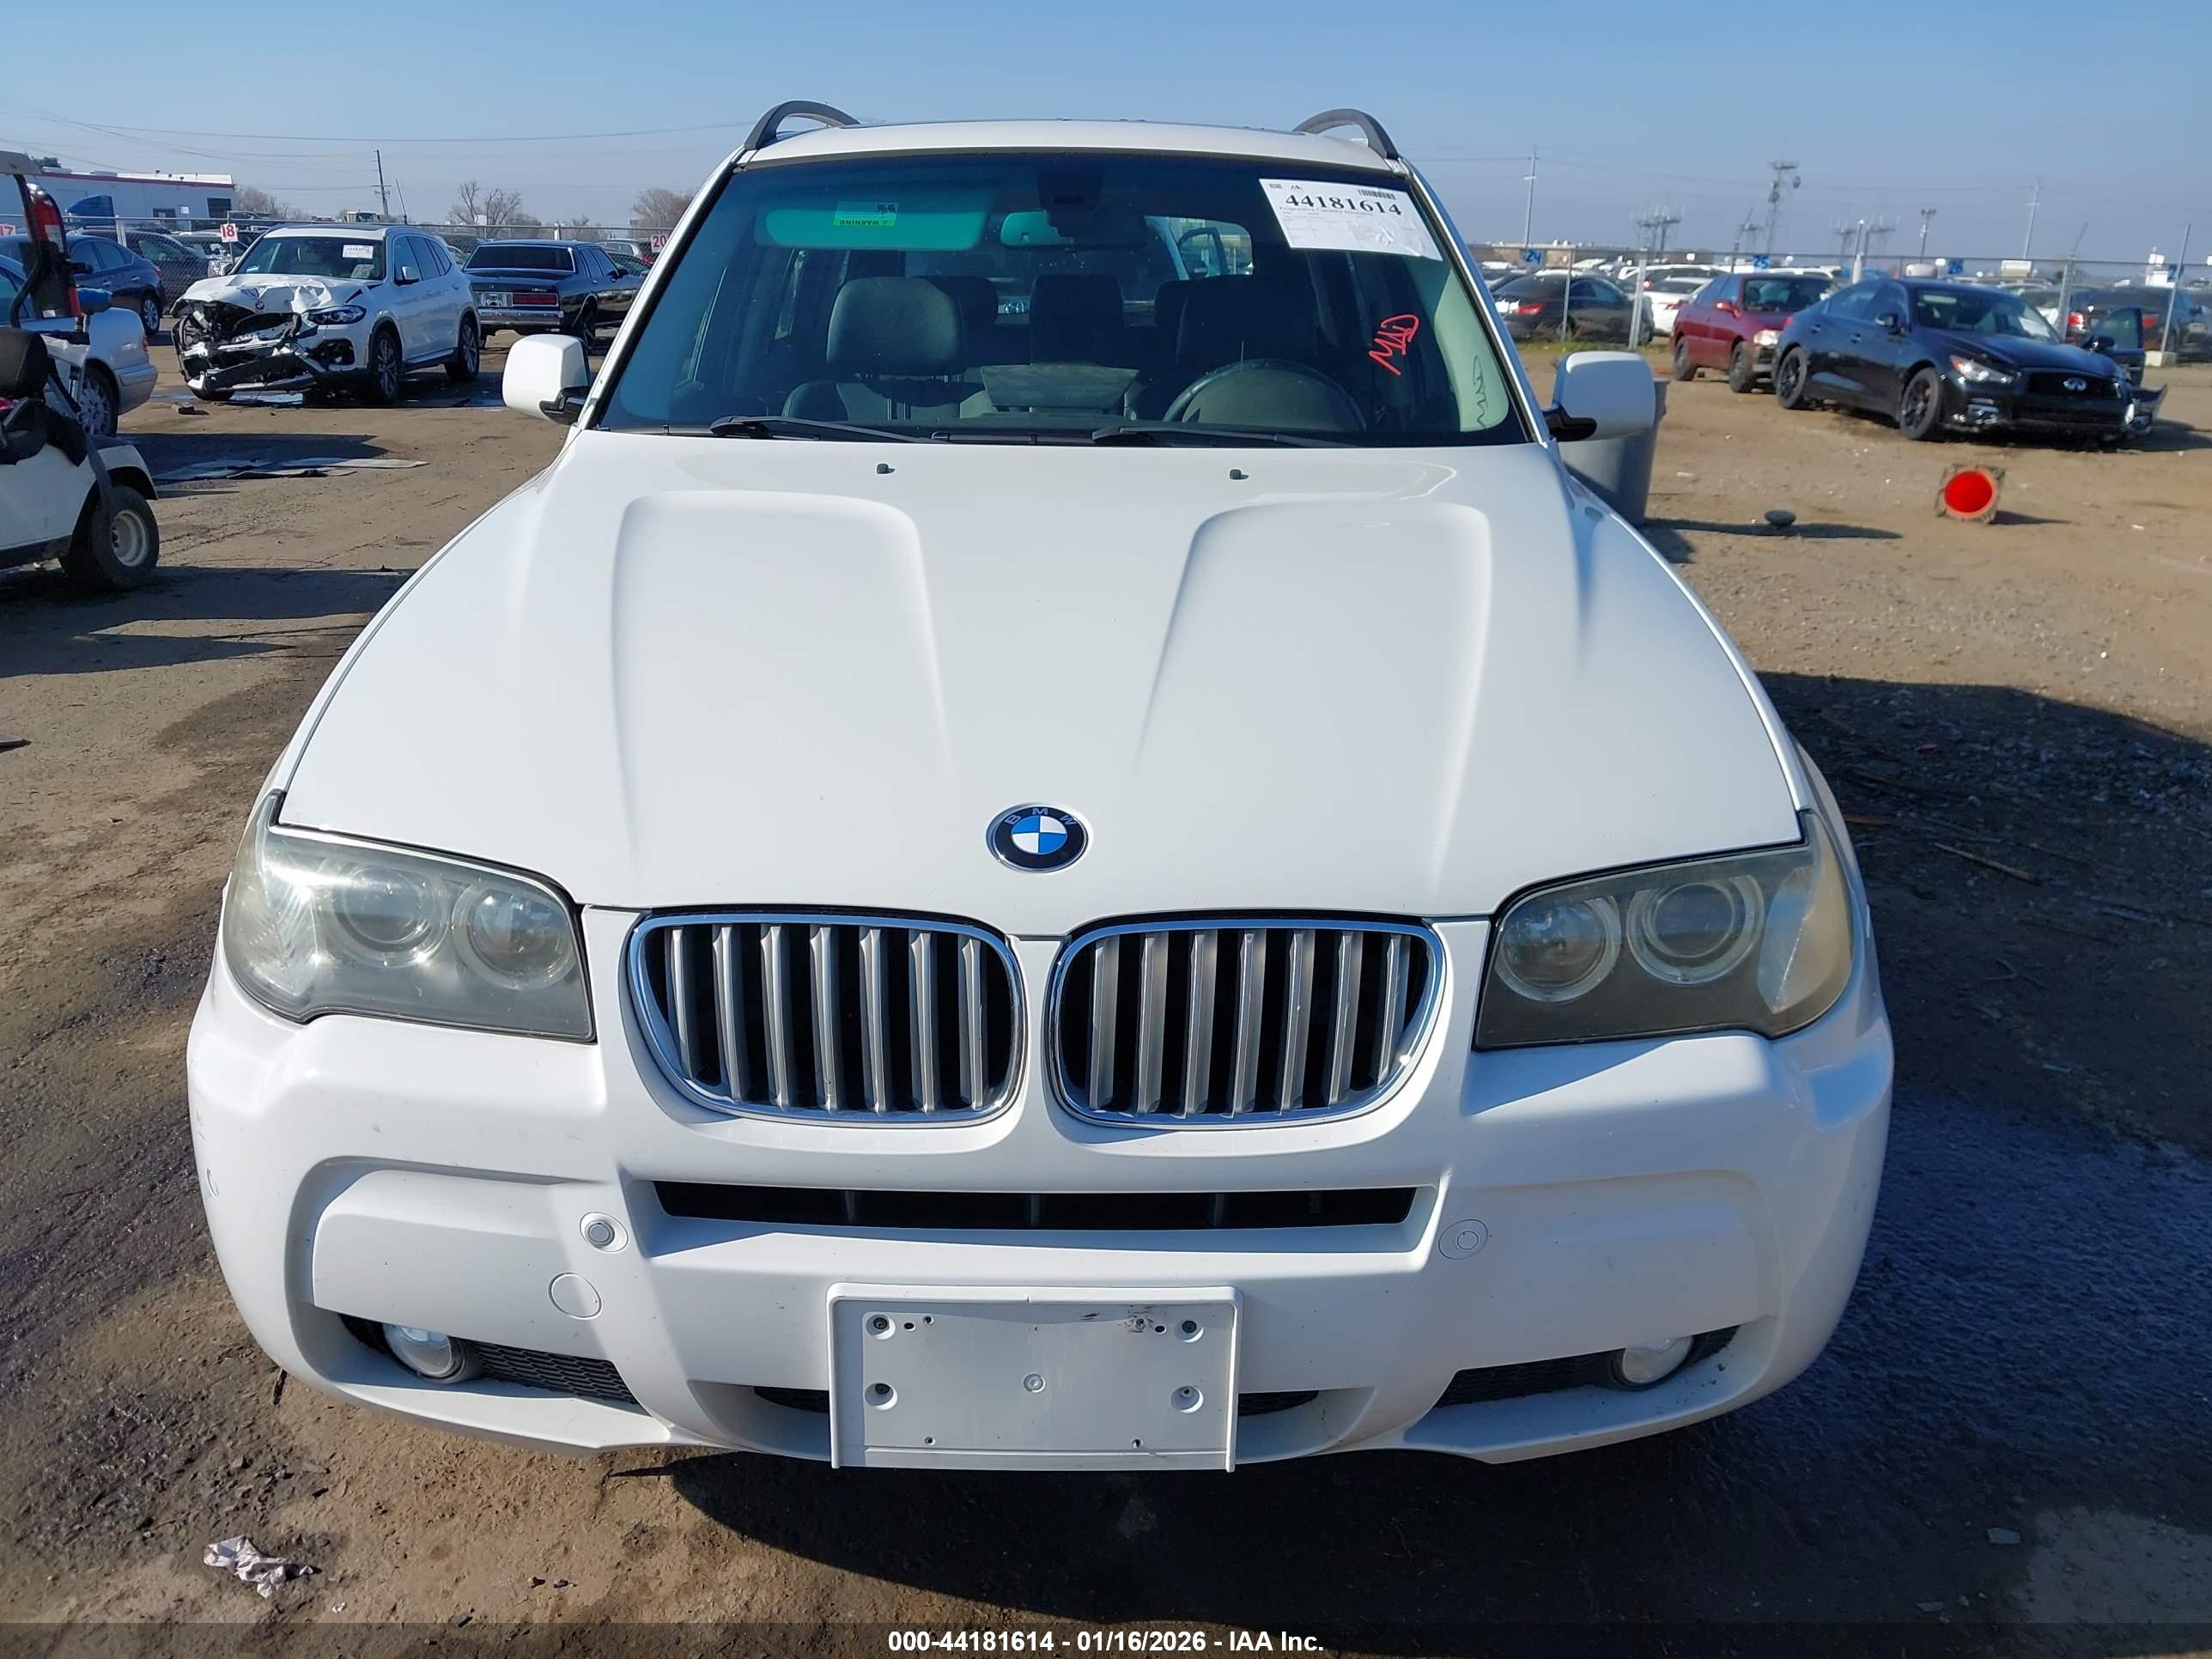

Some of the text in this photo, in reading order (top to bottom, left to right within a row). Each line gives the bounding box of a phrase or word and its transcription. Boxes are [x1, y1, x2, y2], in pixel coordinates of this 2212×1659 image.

[1285, 194, 1402, 216] 44181614
[0, 225, 14, 236] 17
[222, 224, 234, 238] 18
[653, 234, 667, 247] 20
[1525, 249, 1542, 264] 24
[1753, 254, 1769, 269] 25
[1948, 258, 1964, 275] 26
[1004, 807, 1078, 825] BMW
